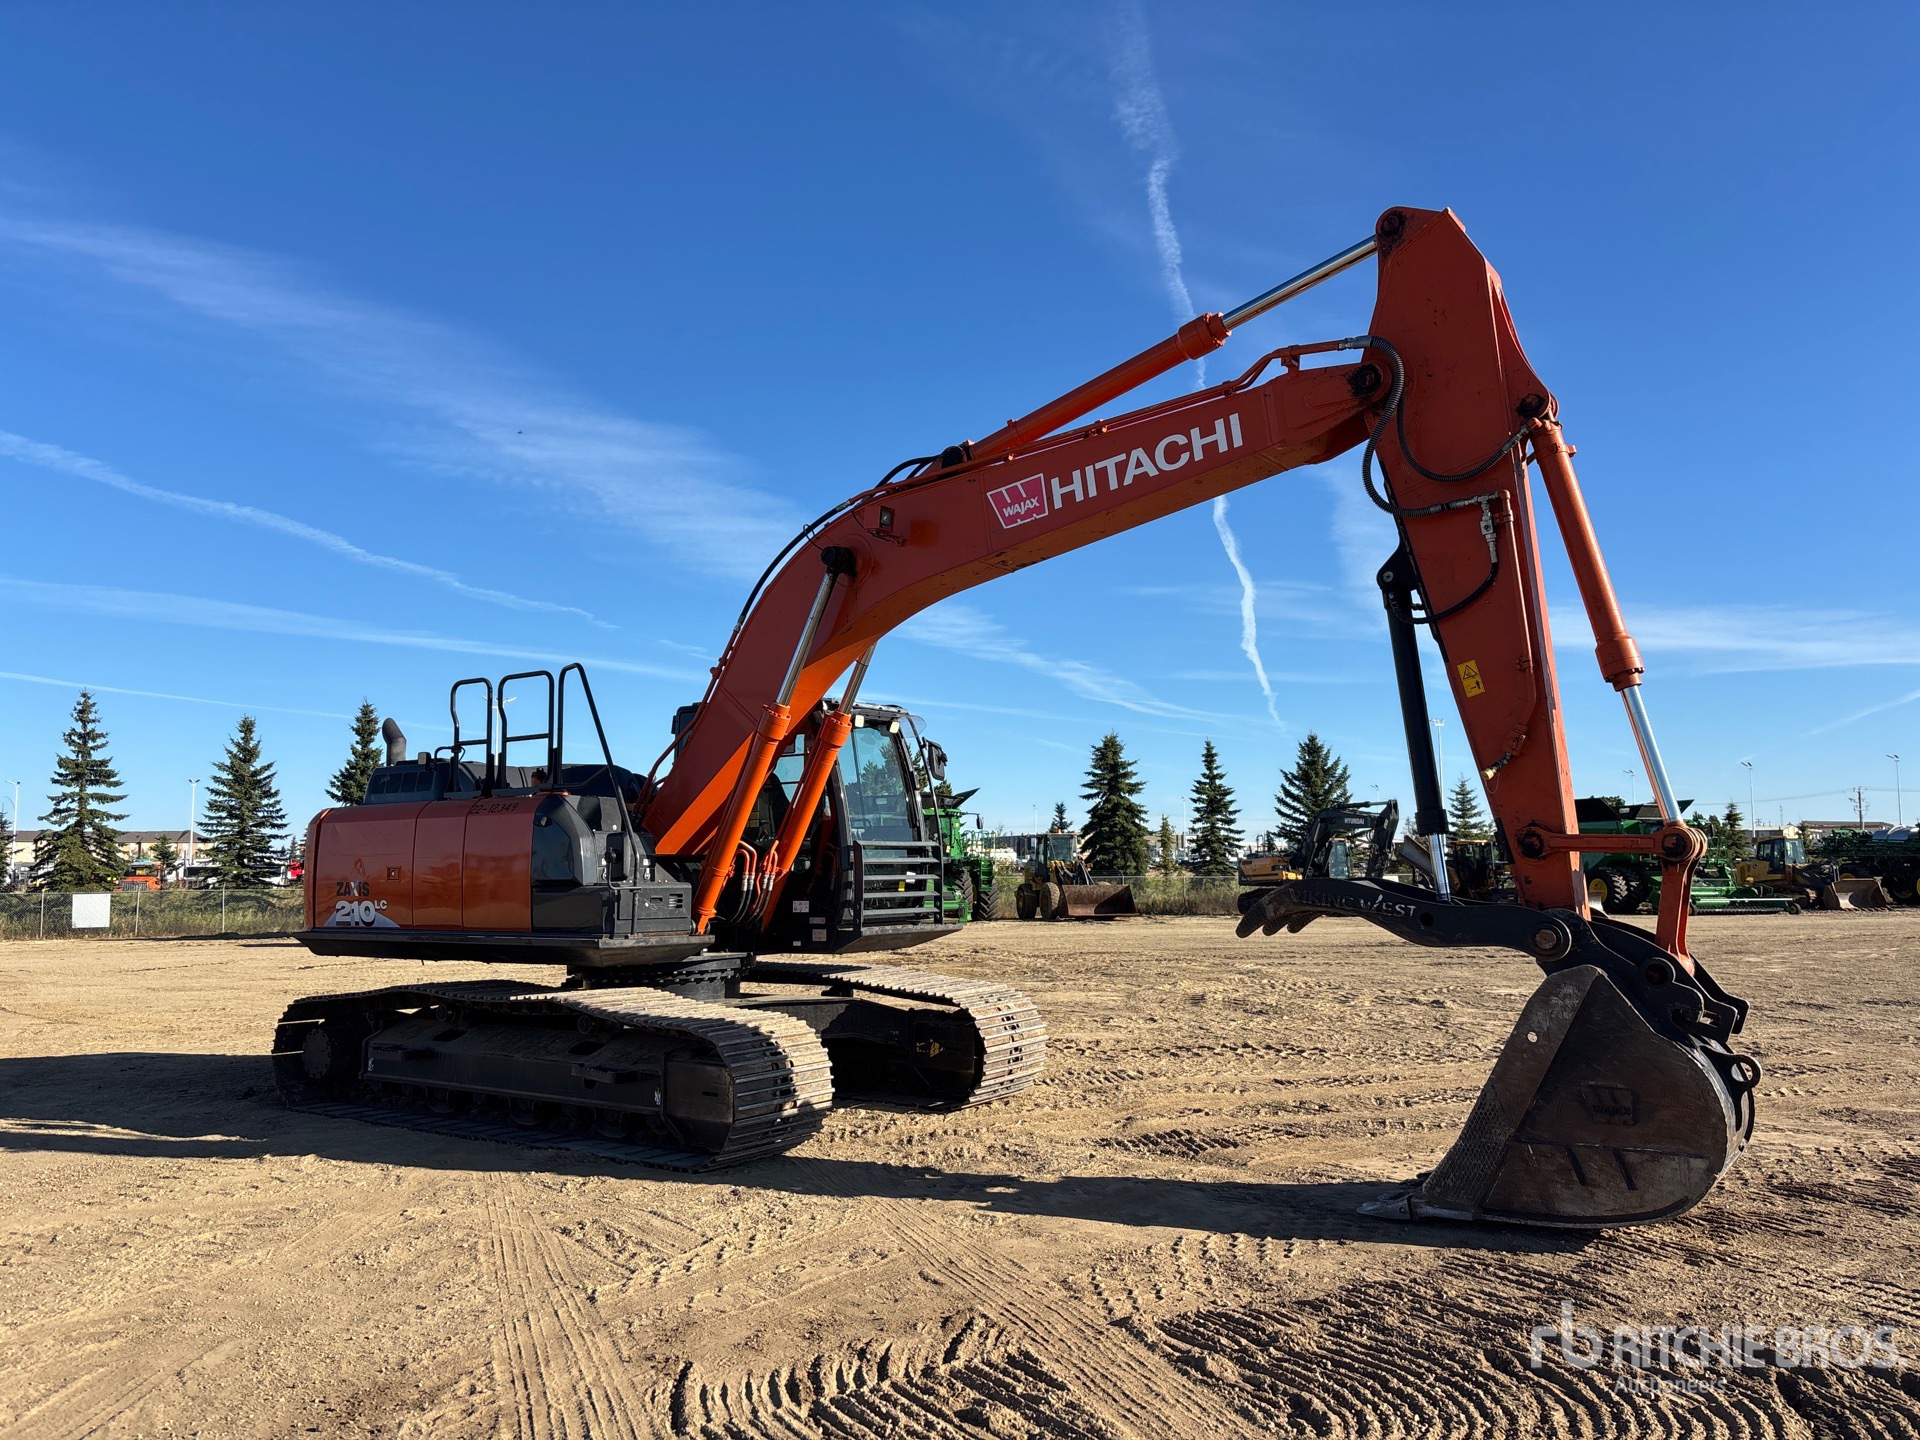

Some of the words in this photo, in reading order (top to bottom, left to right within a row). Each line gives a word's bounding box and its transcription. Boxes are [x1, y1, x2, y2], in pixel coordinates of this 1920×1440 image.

[1051, 413, 1243, 510] HITACHI
[1003, 496, 1040, 517] WAJAX
[336, 880, 370, 897] ZAXIS
